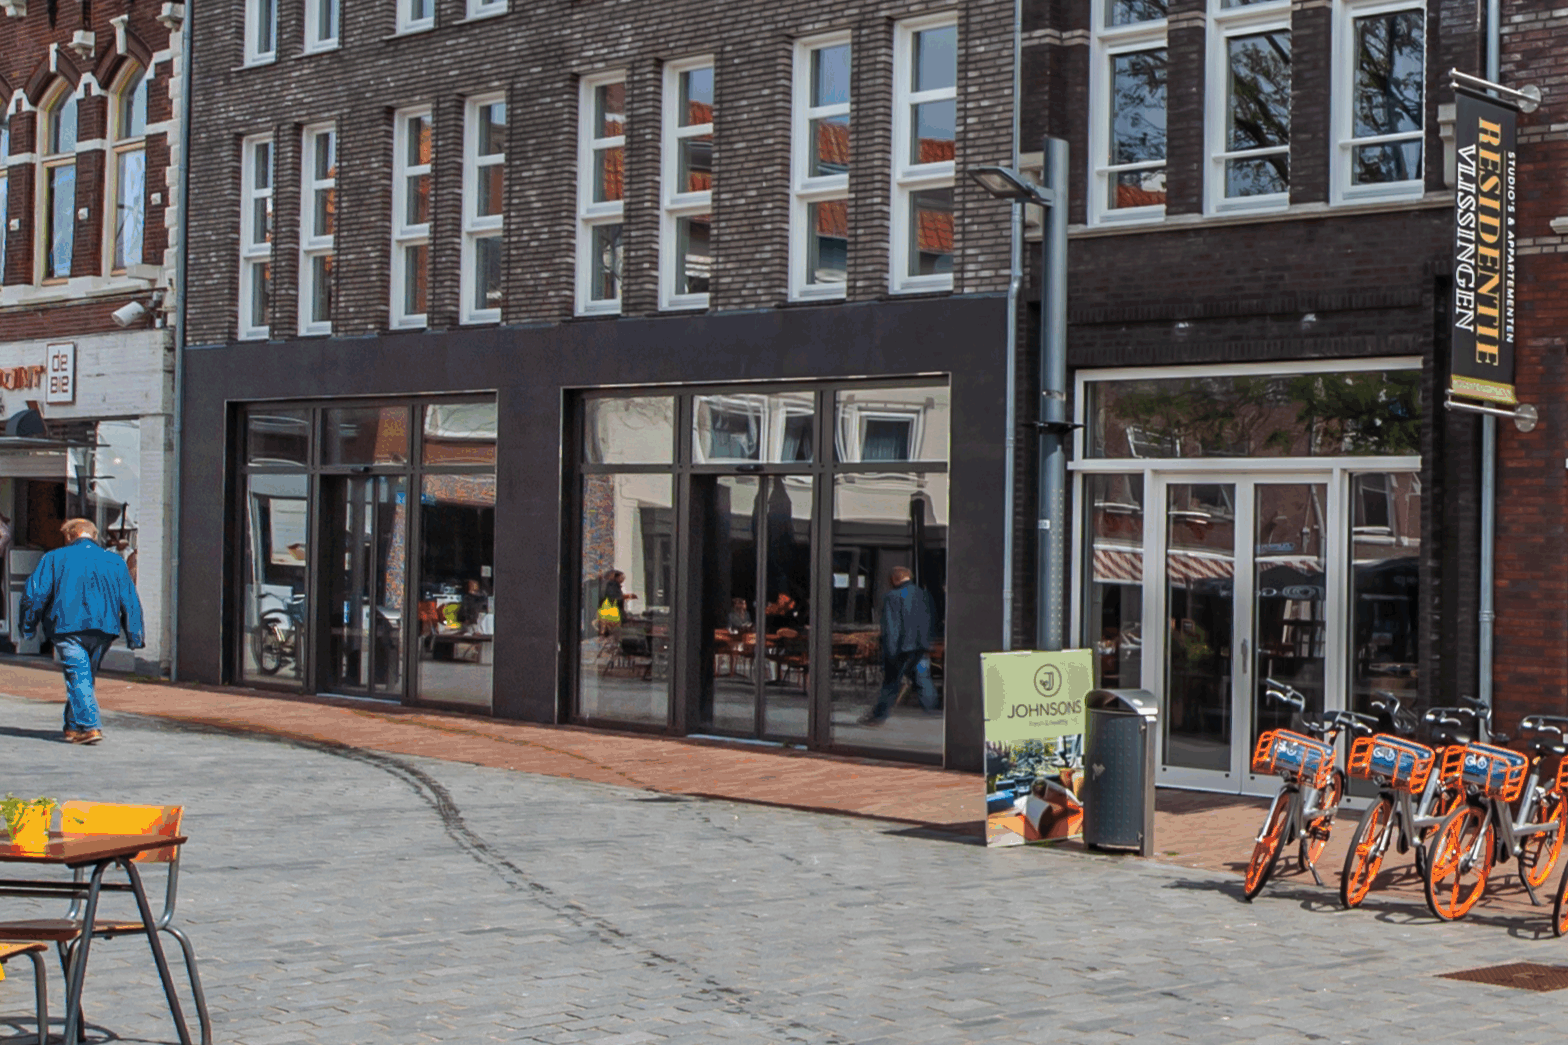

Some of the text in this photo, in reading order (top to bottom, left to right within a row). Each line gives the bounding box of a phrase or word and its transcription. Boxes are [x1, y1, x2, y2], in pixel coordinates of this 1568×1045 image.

[1455, 144, 1476, 332] VLISSINGEN
[1475, 116, 1502, 366] RESIDENTIE
[1506, 151, 1516, 343] STUDIO'S & APPARTEMENTEN
[1007, 700, 1082, 719] JOHNSONS
